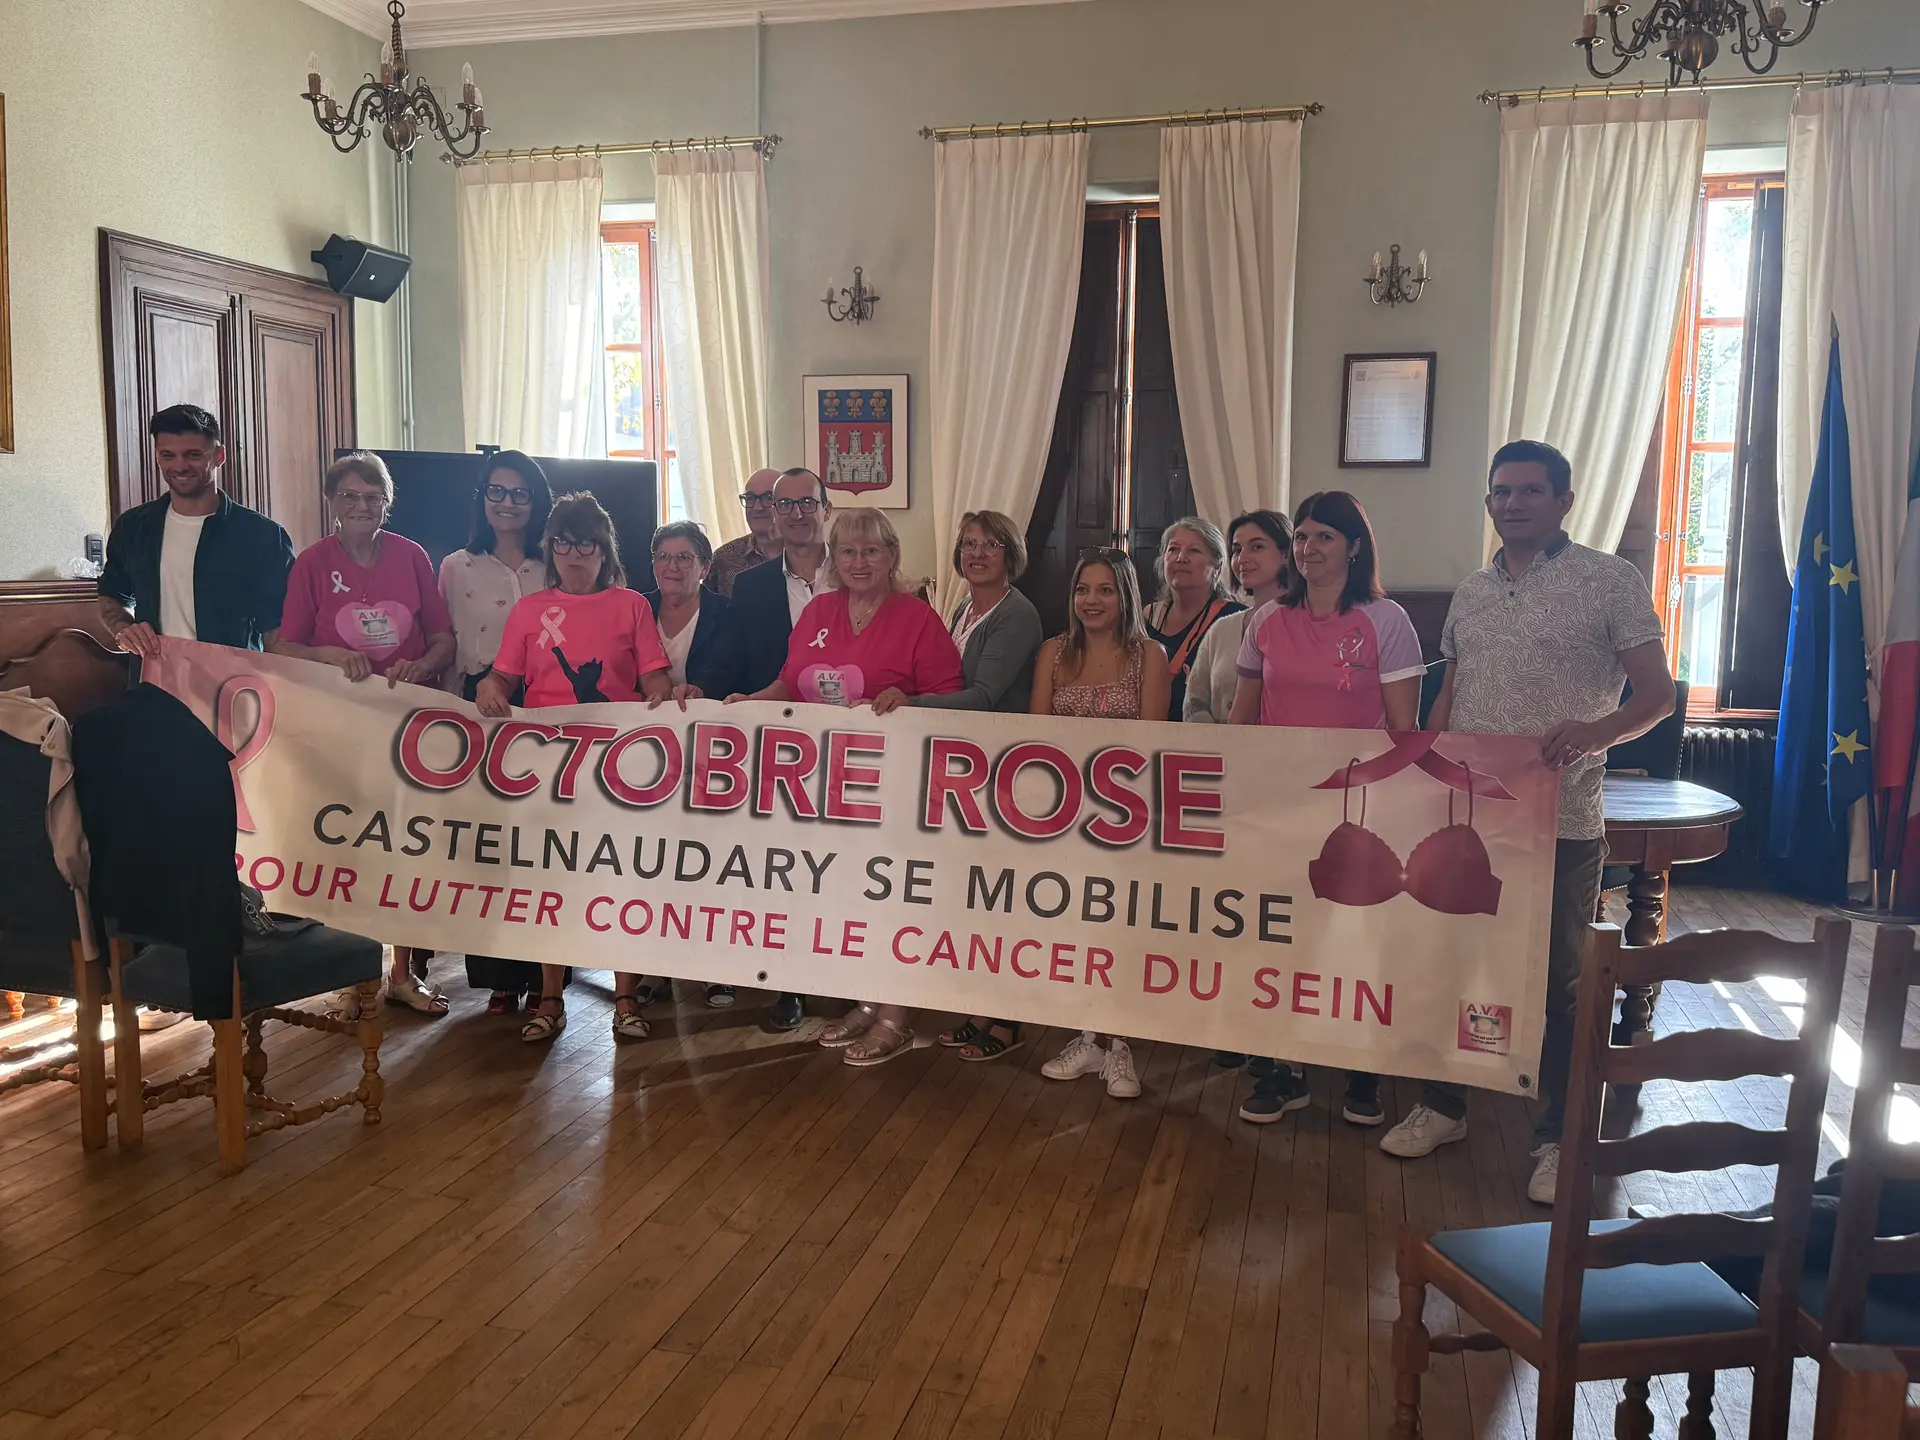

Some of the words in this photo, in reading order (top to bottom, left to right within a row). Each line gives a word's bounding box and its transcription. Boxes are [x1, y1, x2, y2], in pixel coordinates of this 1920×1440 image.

[398, 708, 887, 823] OCTOBRE
[923, 735, 1226, 852] ROSE
[313, 803, 837, 895] CASTELNAUDARY
[863, 855, 934, 905] SE
[966, 865, 1294, 944] MOBILISE
[378, 873, 564, 927] LUTTER
[584, 896, 787, 950] CONTRE
[812, 917, 867, 959] LE
[891, 925, 1115, 989] CANCER
[1143, 954, 1223, 1002] DU
[1250, 966, 1394, 1027] SEIN
